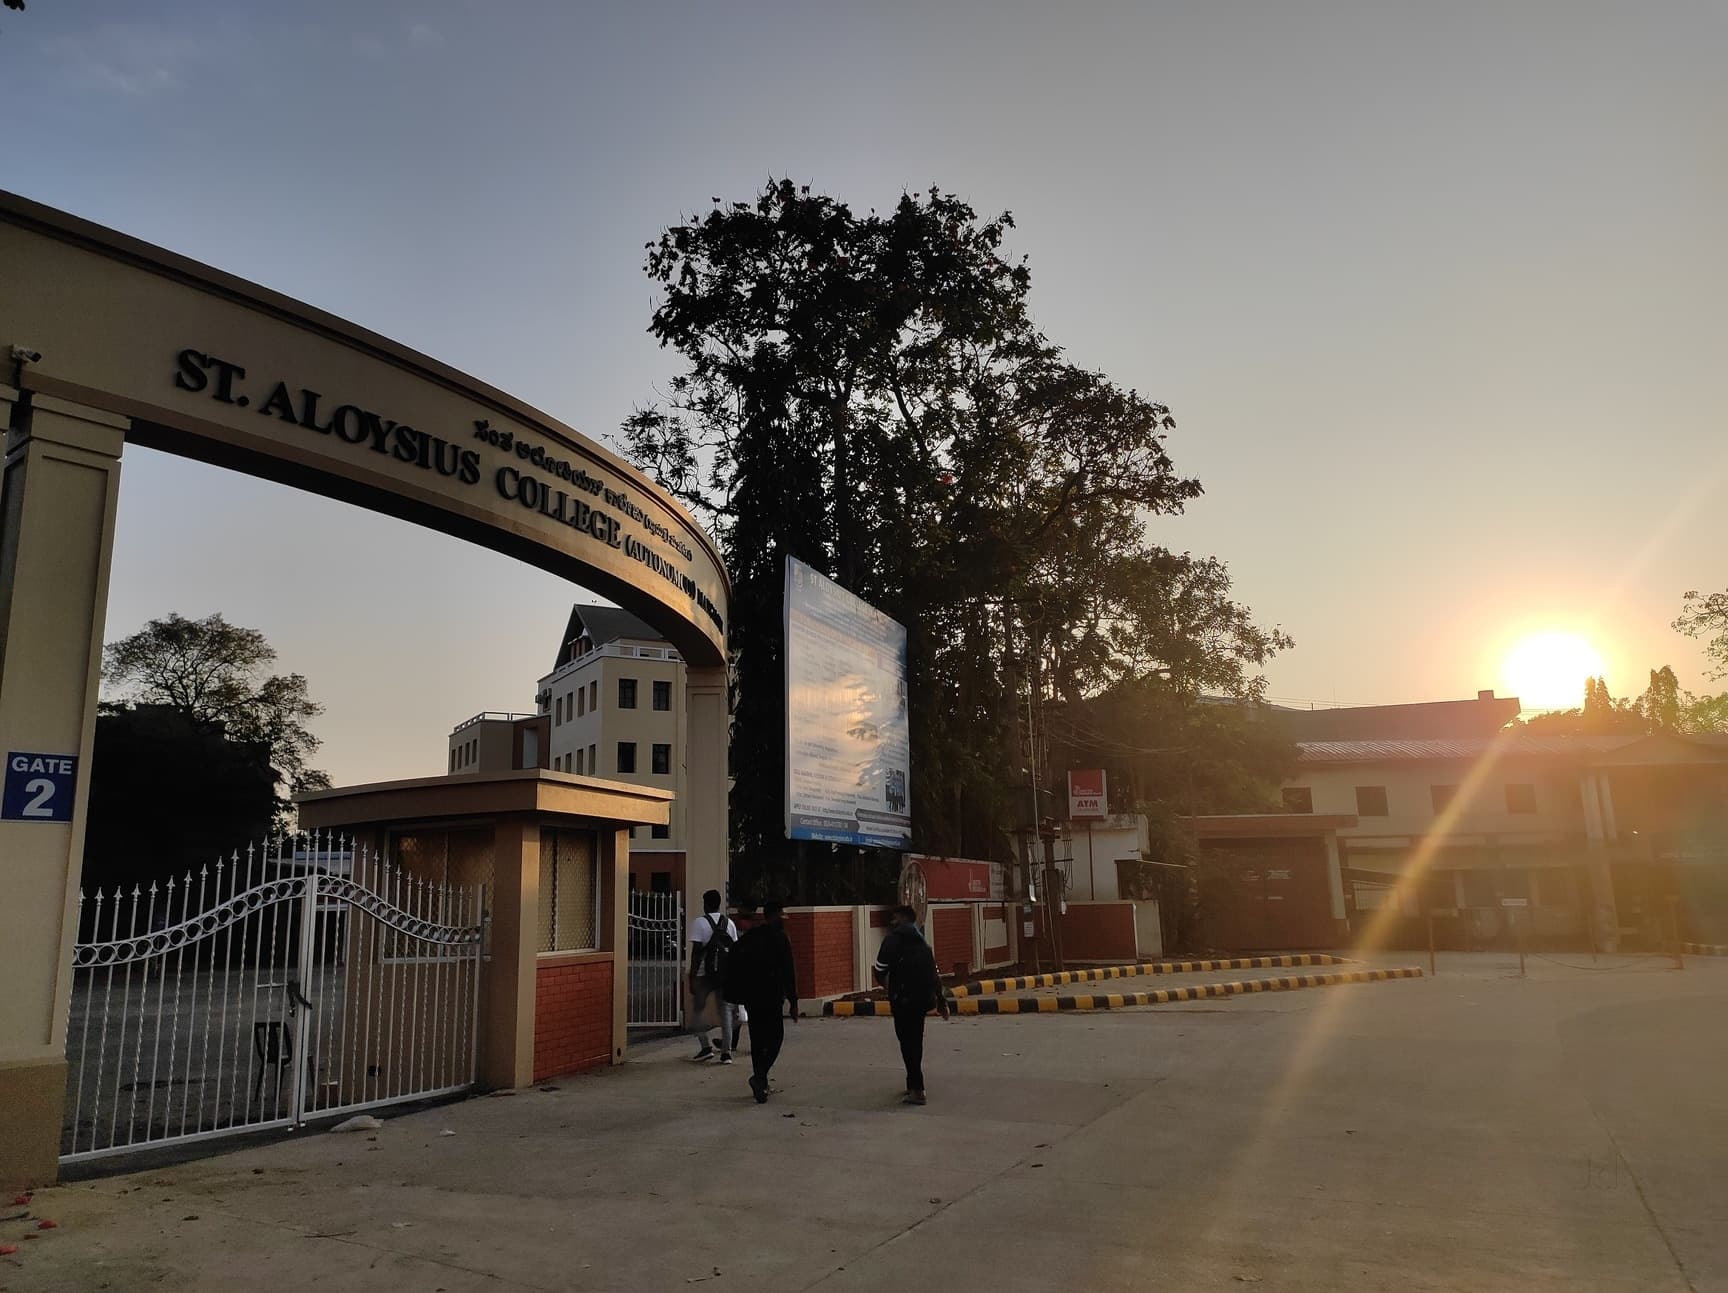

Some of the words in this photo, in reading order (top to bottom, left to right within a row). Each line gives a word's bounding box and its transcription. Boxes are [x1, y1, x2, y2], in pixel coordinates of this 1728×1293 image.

[175, 349, 250, 407] ST.
[258, 381, 481, 485] ALOYSIUS
[497, 466, 621, 549] COLLEGE
[12, 756, 73, 775] GATE
[22, 778, 56, 817] 2
[1077, 799, 1098, 808] ATM
